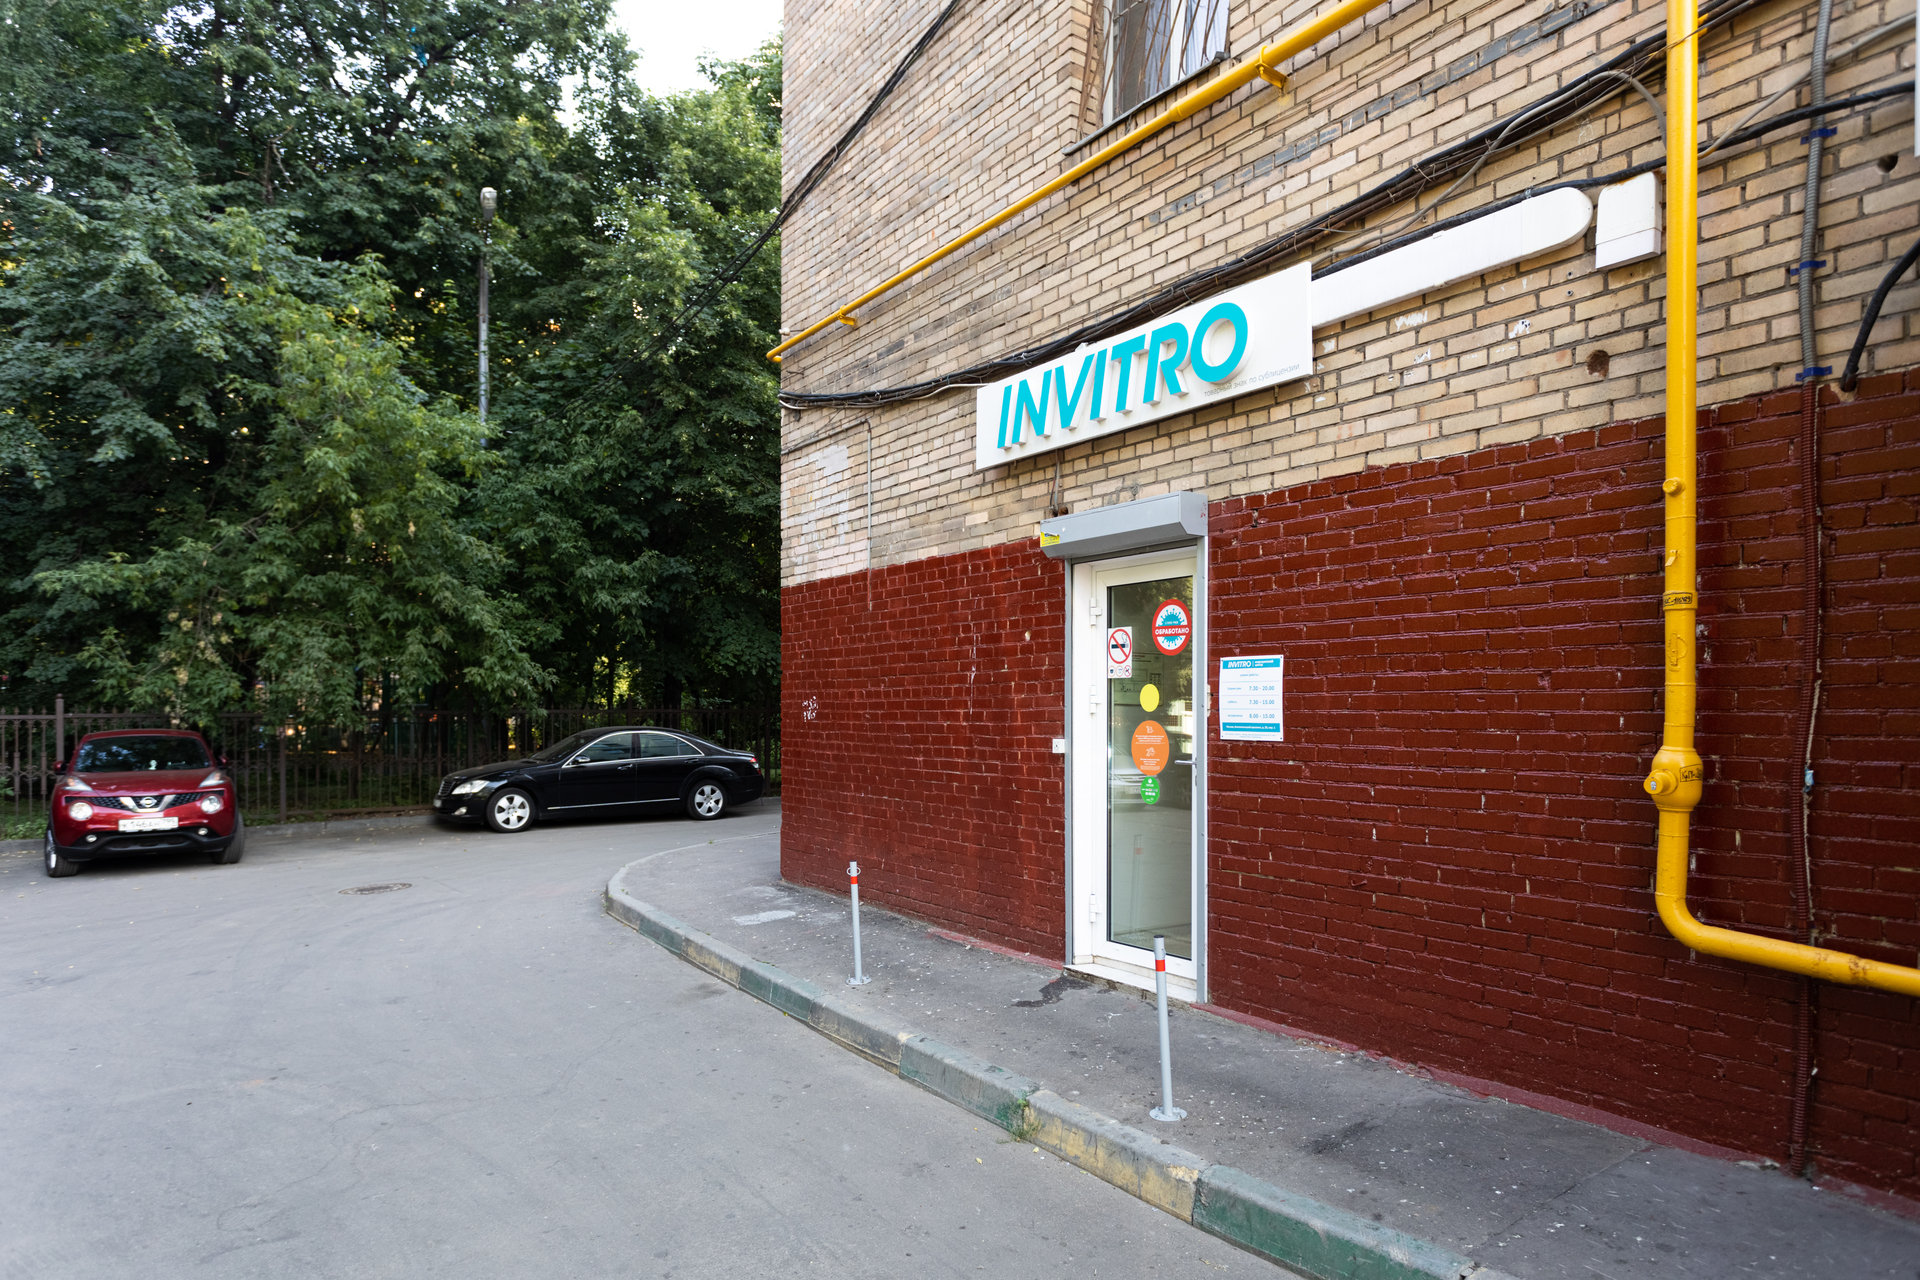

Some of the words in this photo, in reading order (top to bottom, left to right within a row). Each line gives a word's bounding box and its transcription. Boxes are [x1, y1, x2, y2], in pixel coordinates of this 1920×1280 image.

[997, 302, 1250, 450] INVITRO
[1204, 381, 1232, 397] товарный
[1234, 379, 1248, 388] знак
[1258, 364, 1300, 382] сублицензии
